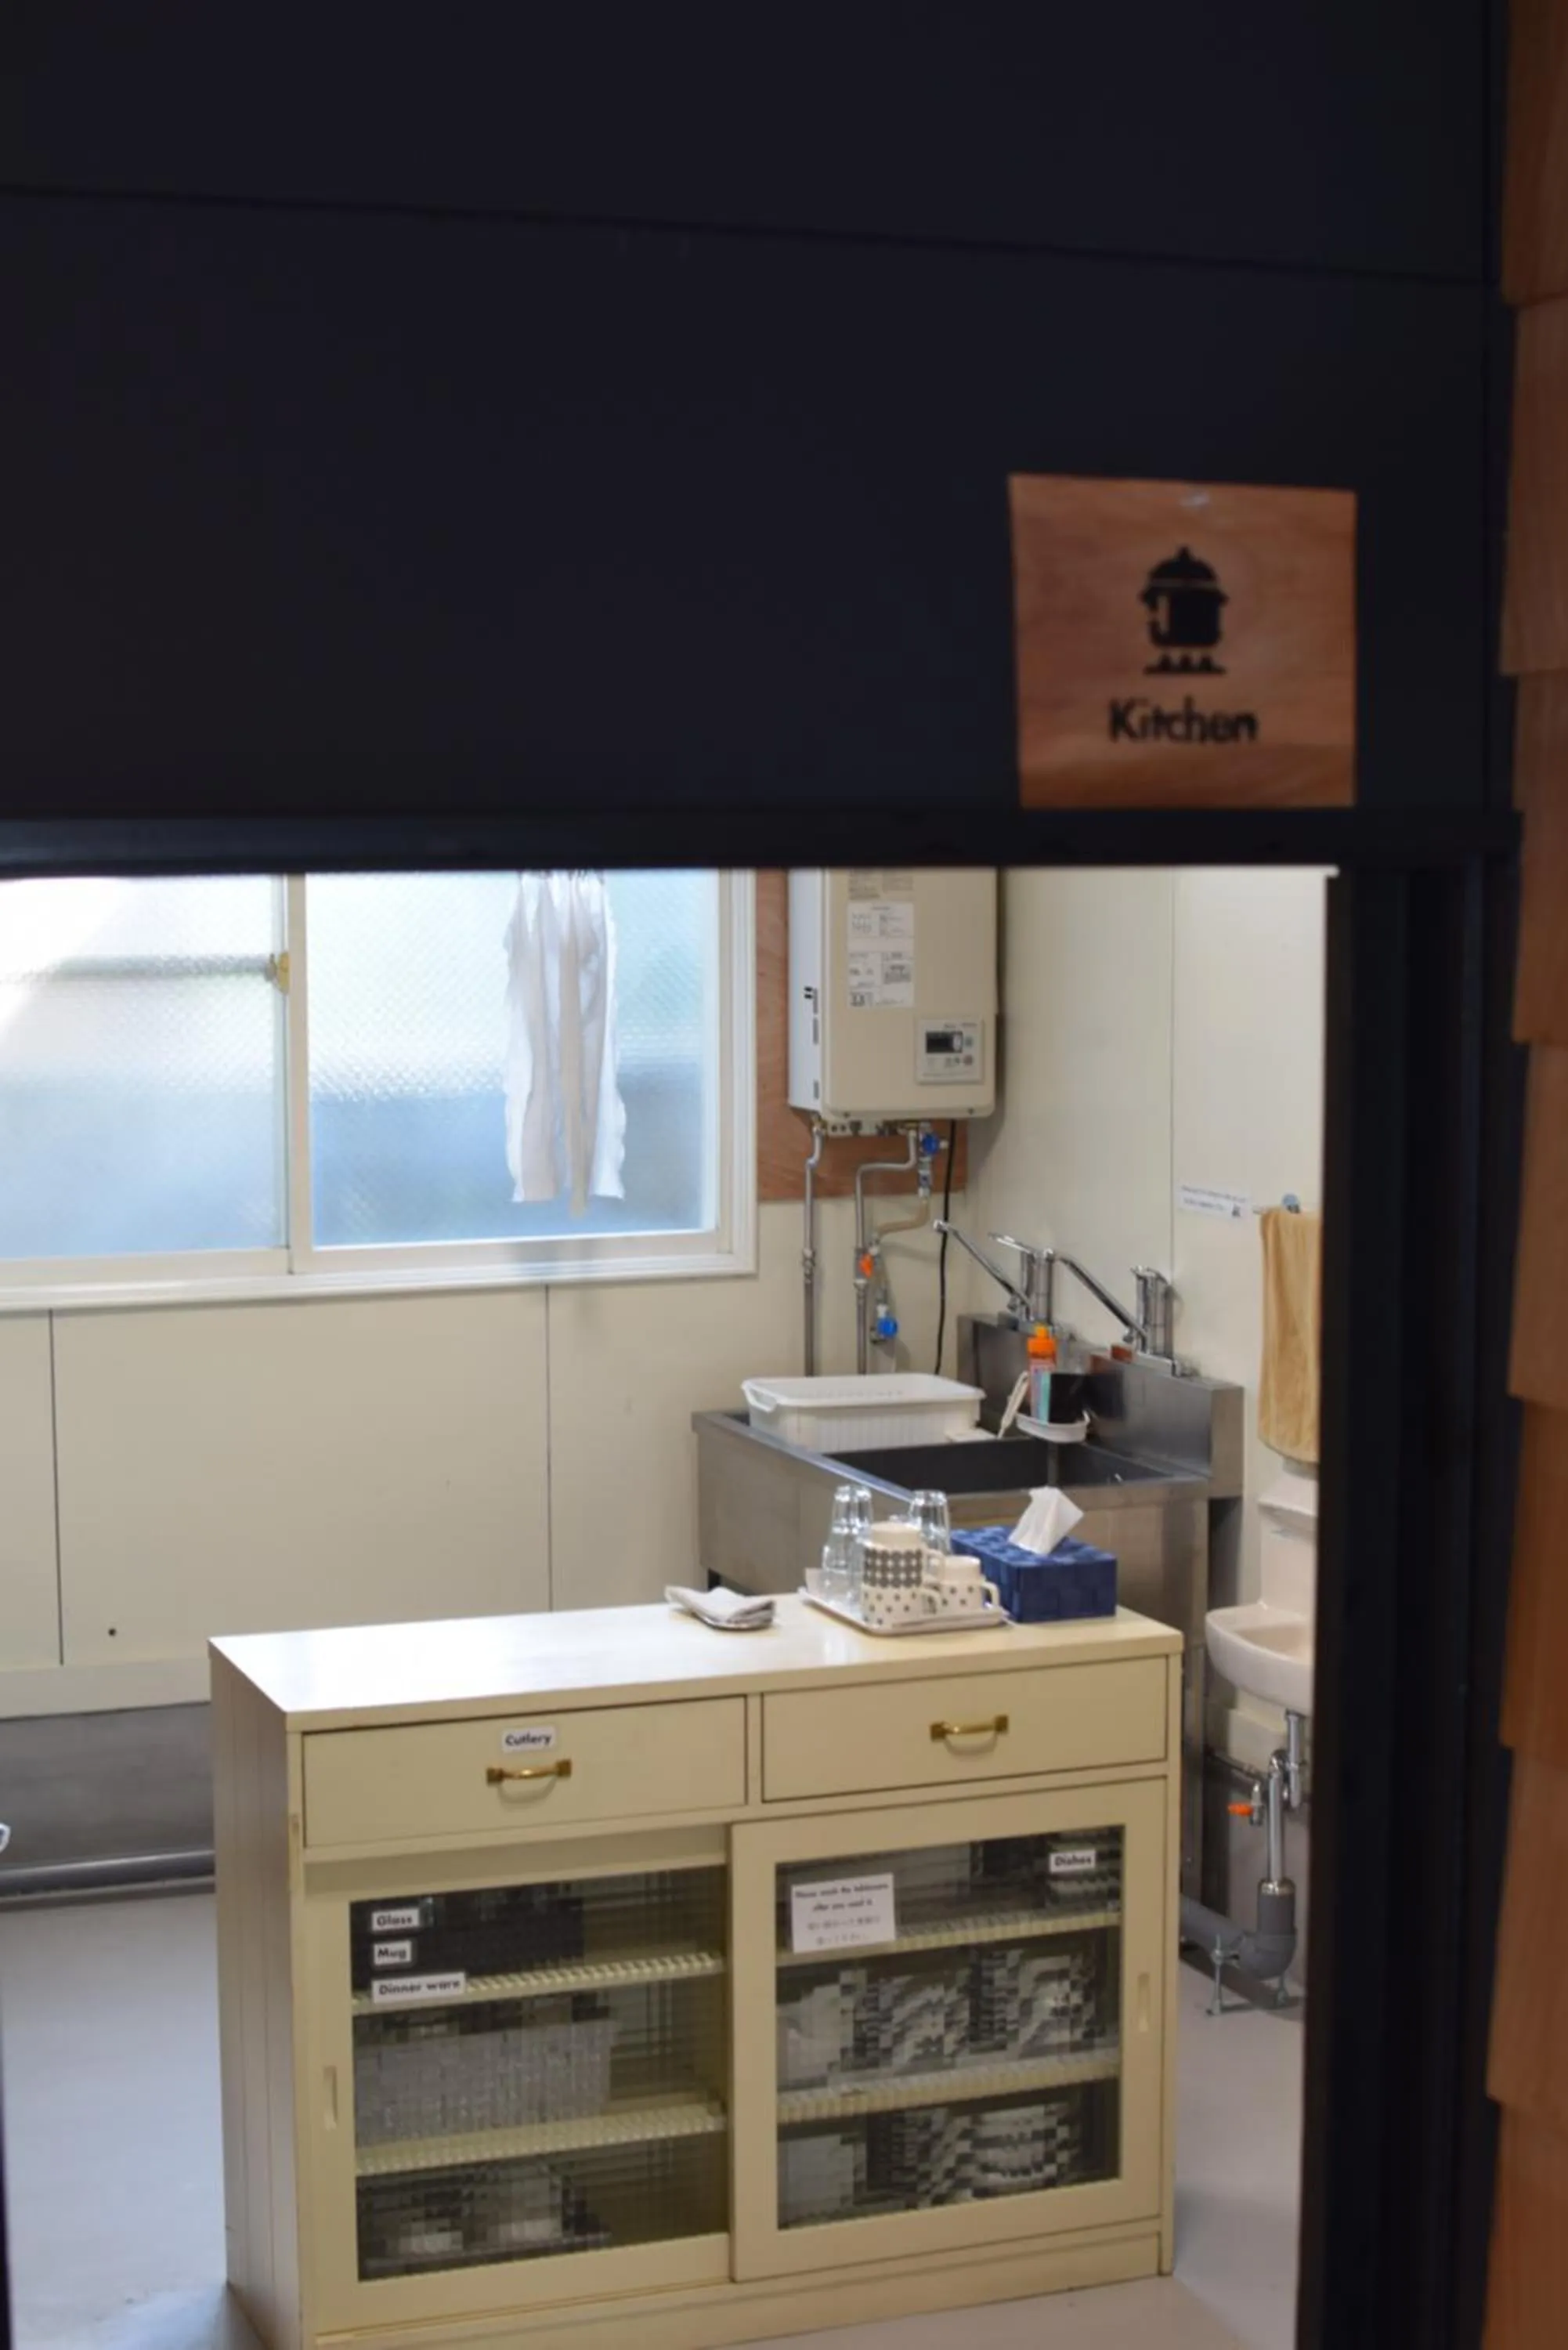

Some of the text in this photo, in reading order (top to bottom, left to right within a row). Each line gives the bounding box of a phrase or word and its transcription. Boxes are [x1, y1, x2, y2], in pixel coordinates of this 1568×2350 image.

[1108, 695, 1259, 744] Kitchen
[505, 1731, 551, 1746] Cutlery
[1054, 1853, 1092, 1867] Dishes
[377, 1914, 412, 1926] Glass
[378, 1947, 406, 1960] Mug
[379, 1978, 460, 1994] Dinner ware
